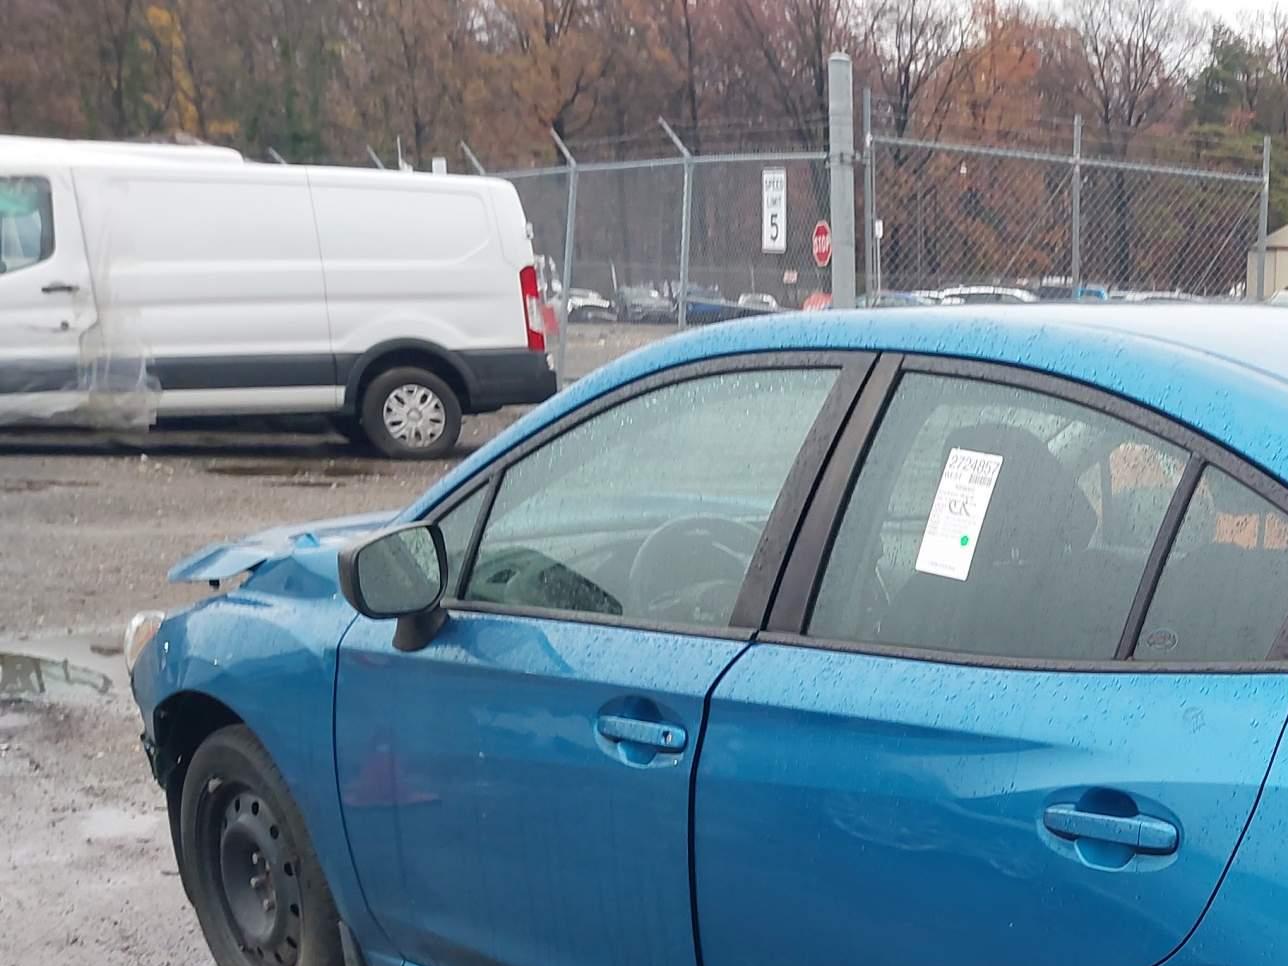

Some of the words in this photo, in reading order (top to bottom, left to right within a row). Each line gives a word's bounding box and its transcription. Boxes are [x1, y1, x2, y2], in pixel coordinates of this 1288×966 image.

[765, 178, 784, 192] SPEED
[766, 195, 783, 209] LIMIT
[770, 213, 780, 241] 5
[814, 236, 831, 251] STOP
